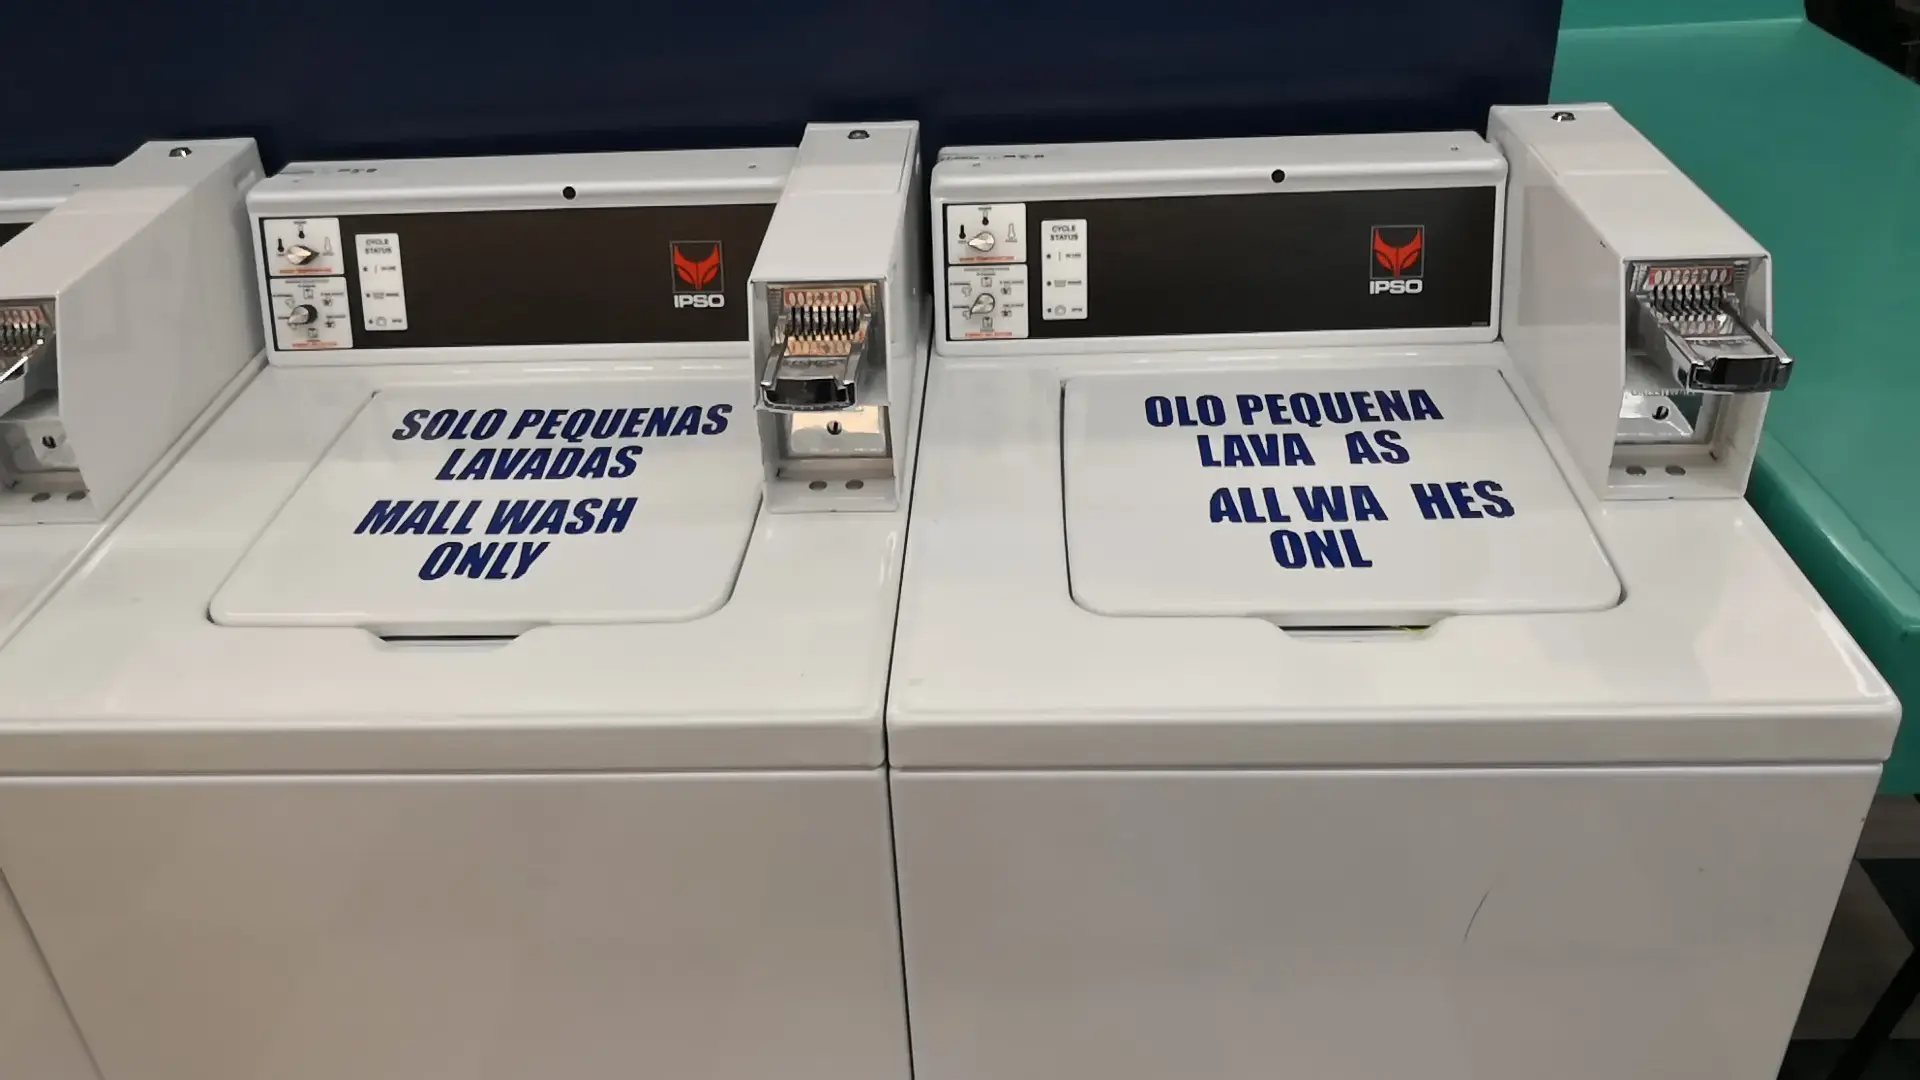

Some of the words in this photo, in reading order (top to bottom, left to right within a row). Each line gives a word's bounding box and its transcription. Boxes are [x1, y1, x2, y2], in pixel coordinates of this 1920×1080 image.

[673, 294, 725, 308] IPSO
[1369, 279, 1423, 295] IPSO
[392, 408, 507, 441] SOLO
[507, 404, 733, 442] PEQUENAS
[1145, 395, 1226, 427] OLO
[1236, 389, 1444, 427] PEQUENA
[435, 445, 643, 481] LAVADAS
[353, 499, 483, 535] MALL
[484, 497, 639, 535] WASH
[1209, 486, 1292, 523] ALL
[417, 541, 550, 581] ONLY
[1269, 529, 1373, 569] ONL
